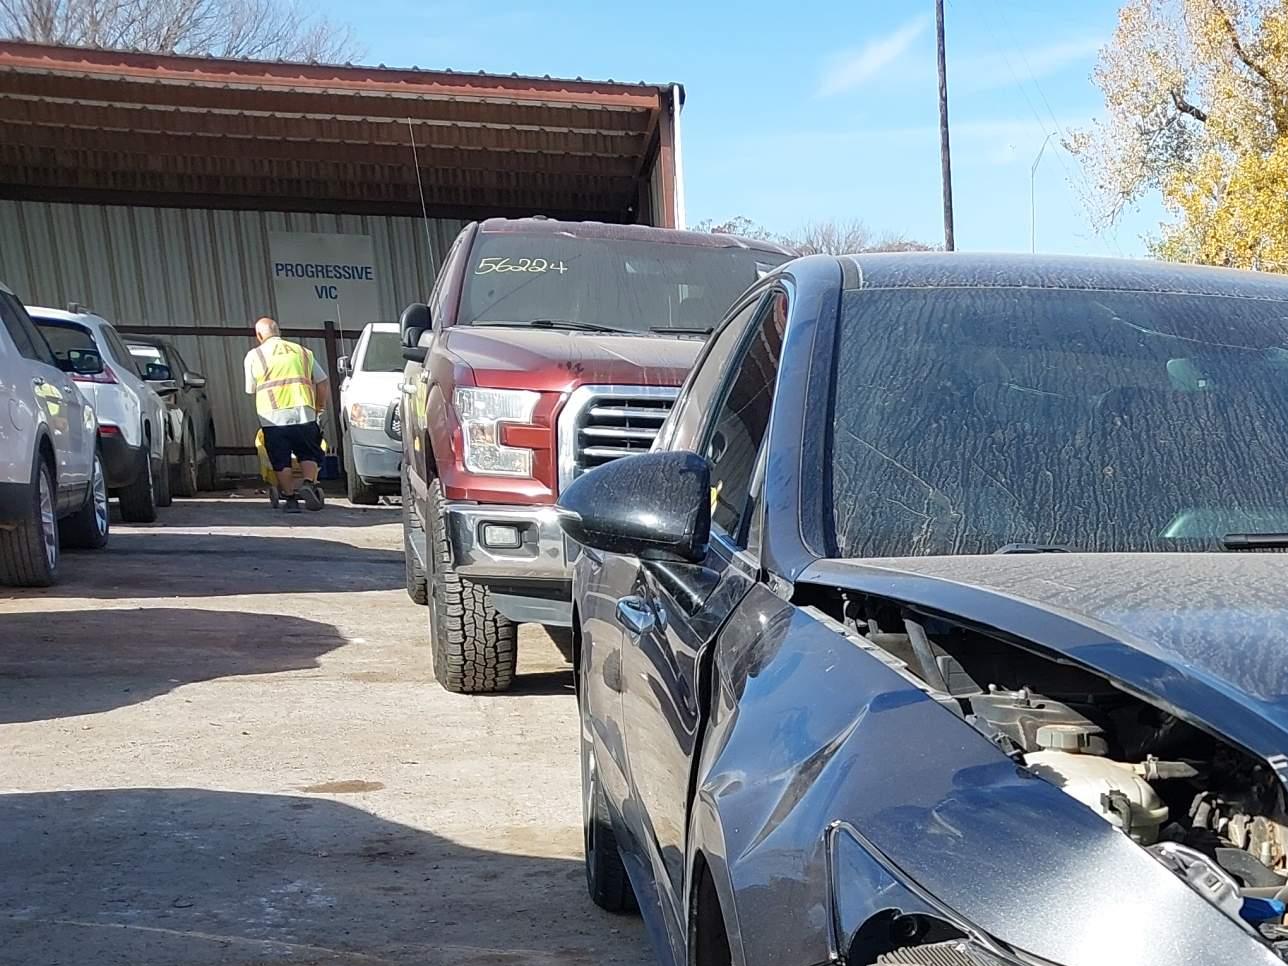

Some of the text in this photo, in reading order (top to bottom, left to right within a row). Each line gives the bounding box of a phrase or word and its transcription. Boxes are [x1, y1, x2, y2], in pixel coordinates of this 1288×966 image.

[275, 263, 373, 280] PROGRESSIVE
[475, 257, 568, 275] 56224
[315, 285, 338, 299] VIC
